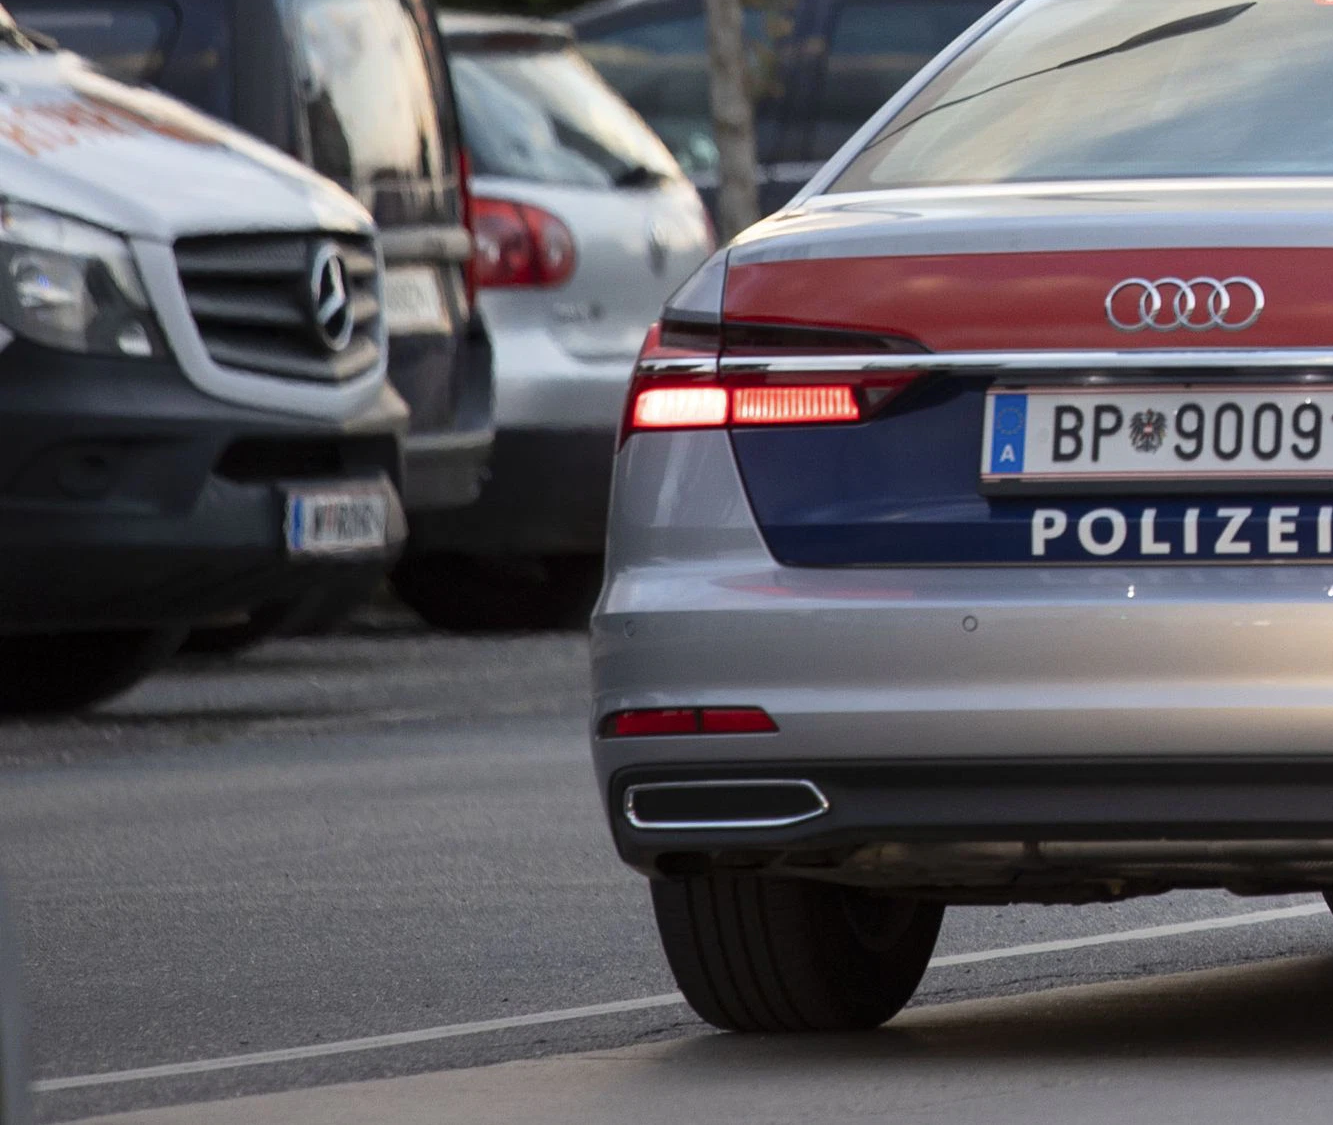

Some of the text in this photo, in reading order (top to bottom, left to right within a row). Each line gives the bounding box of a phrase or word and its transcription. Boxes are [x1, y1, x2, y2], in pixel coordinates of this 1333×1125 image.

[1000, 444, 1016, 464] A
[1052, 404, 1123, 462] BP
[1031, 506, 1333, 556] POLIZEI
